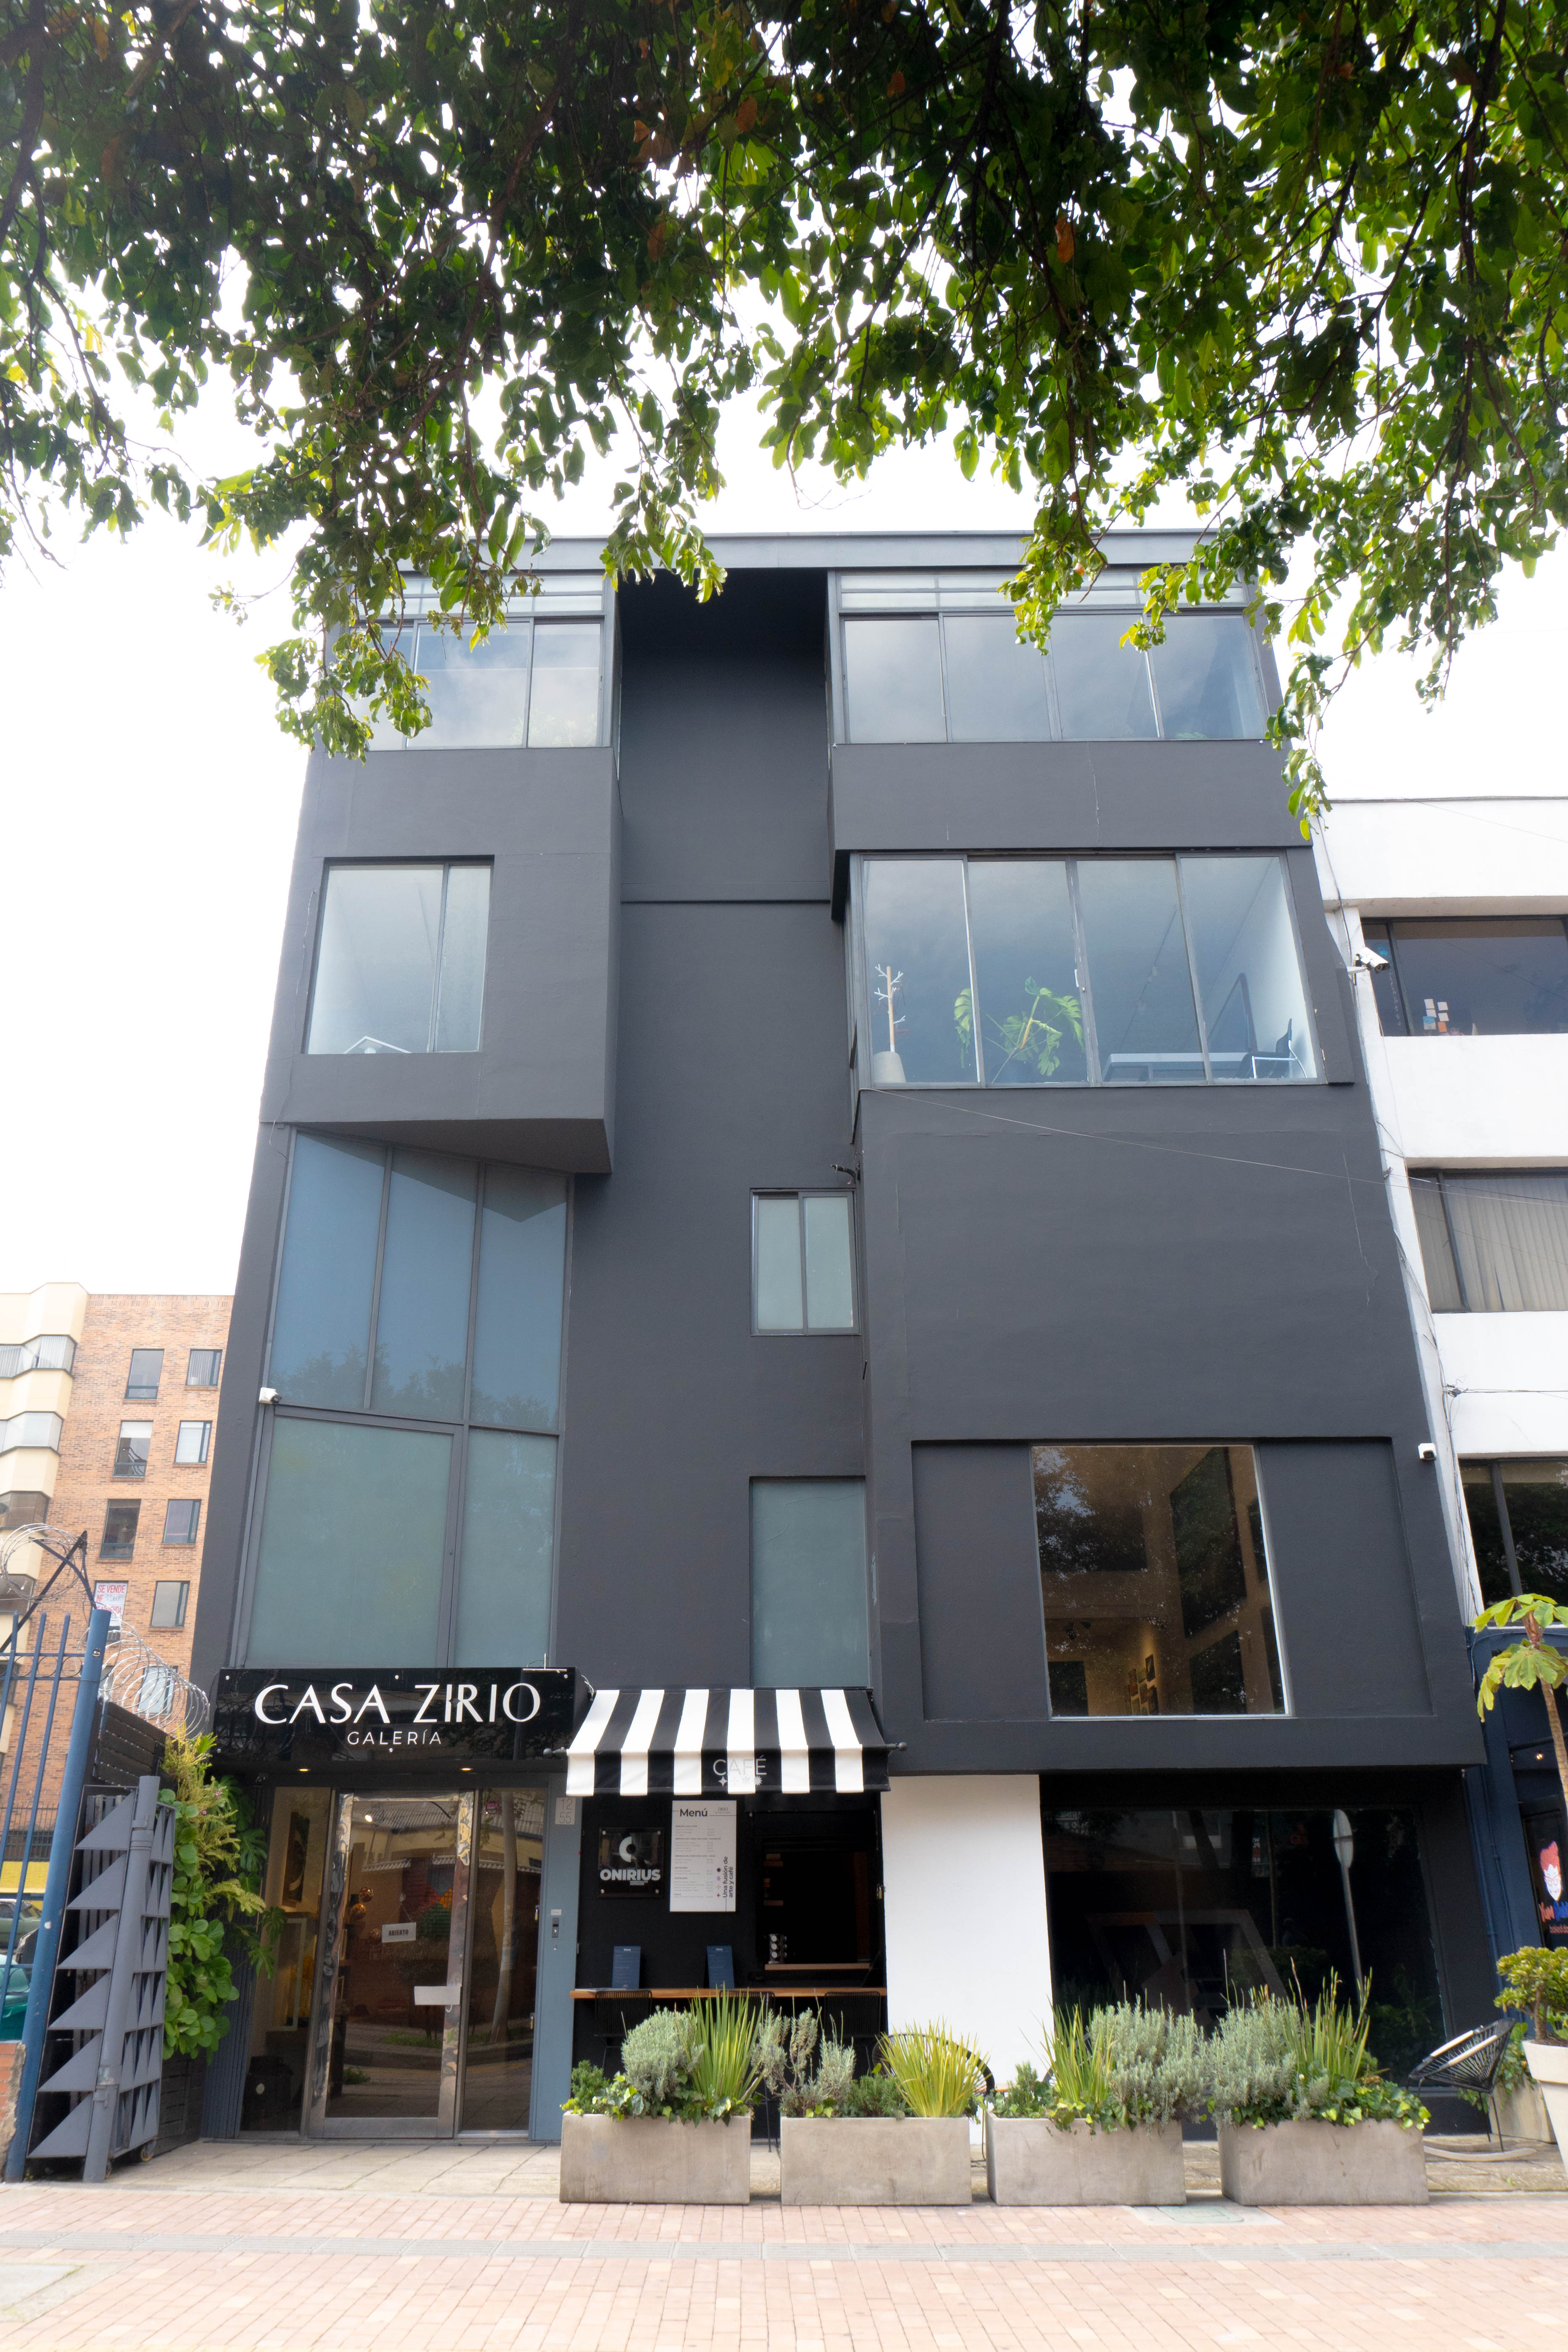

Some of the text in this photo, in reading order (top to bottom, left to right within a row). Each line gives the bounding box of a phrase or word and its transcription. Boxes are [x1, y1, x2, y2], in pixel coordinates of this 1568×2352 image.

[107, 1585, 126, 1593] VENDE
[254, 1683, 541, 1724] CASA ZIRIO
[347, 1729, 442, 1745] GALERÍA
[713, 1755, 767, 1776] CAFÉ
[562, 1798, 573, 1810] 12
[559, 1812, 572, 1824] 55
[680, 1808, 707, 1817] Menú
[600, 1869, 661, 1881] ONIRIUS
